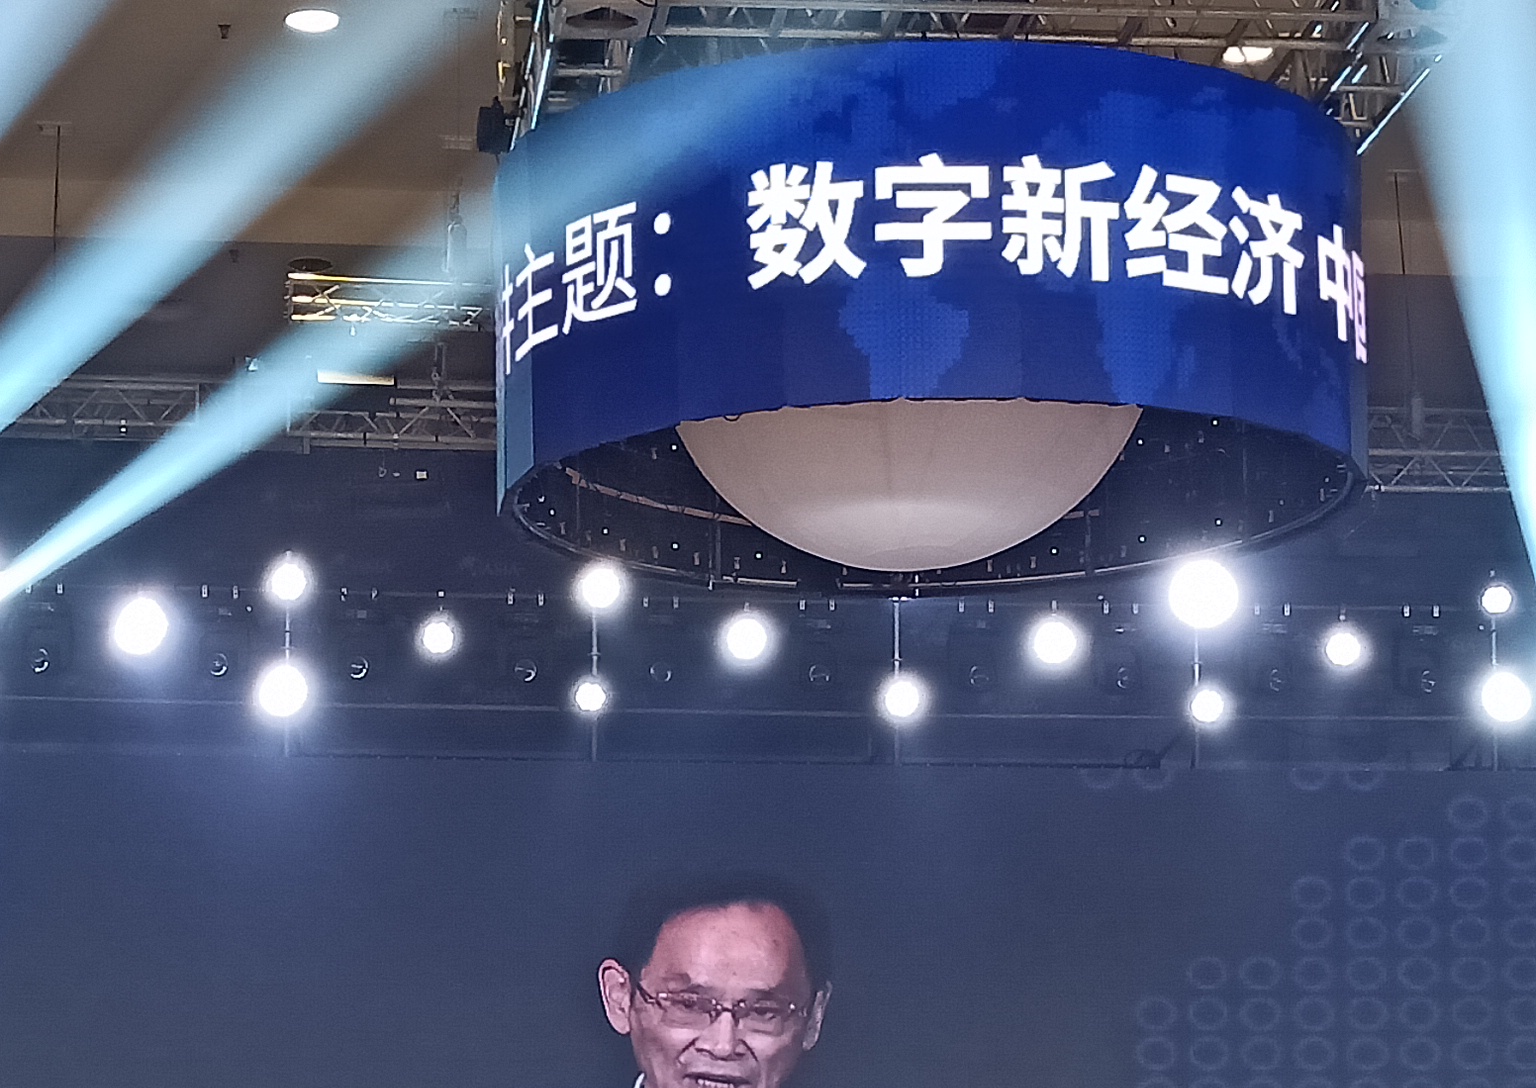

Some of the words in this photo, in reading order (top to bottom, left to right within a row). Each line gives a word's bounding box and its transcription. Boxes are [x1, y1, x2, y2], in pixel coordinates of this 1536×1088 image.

[747, 152, 1305, 316] 数字新经济
